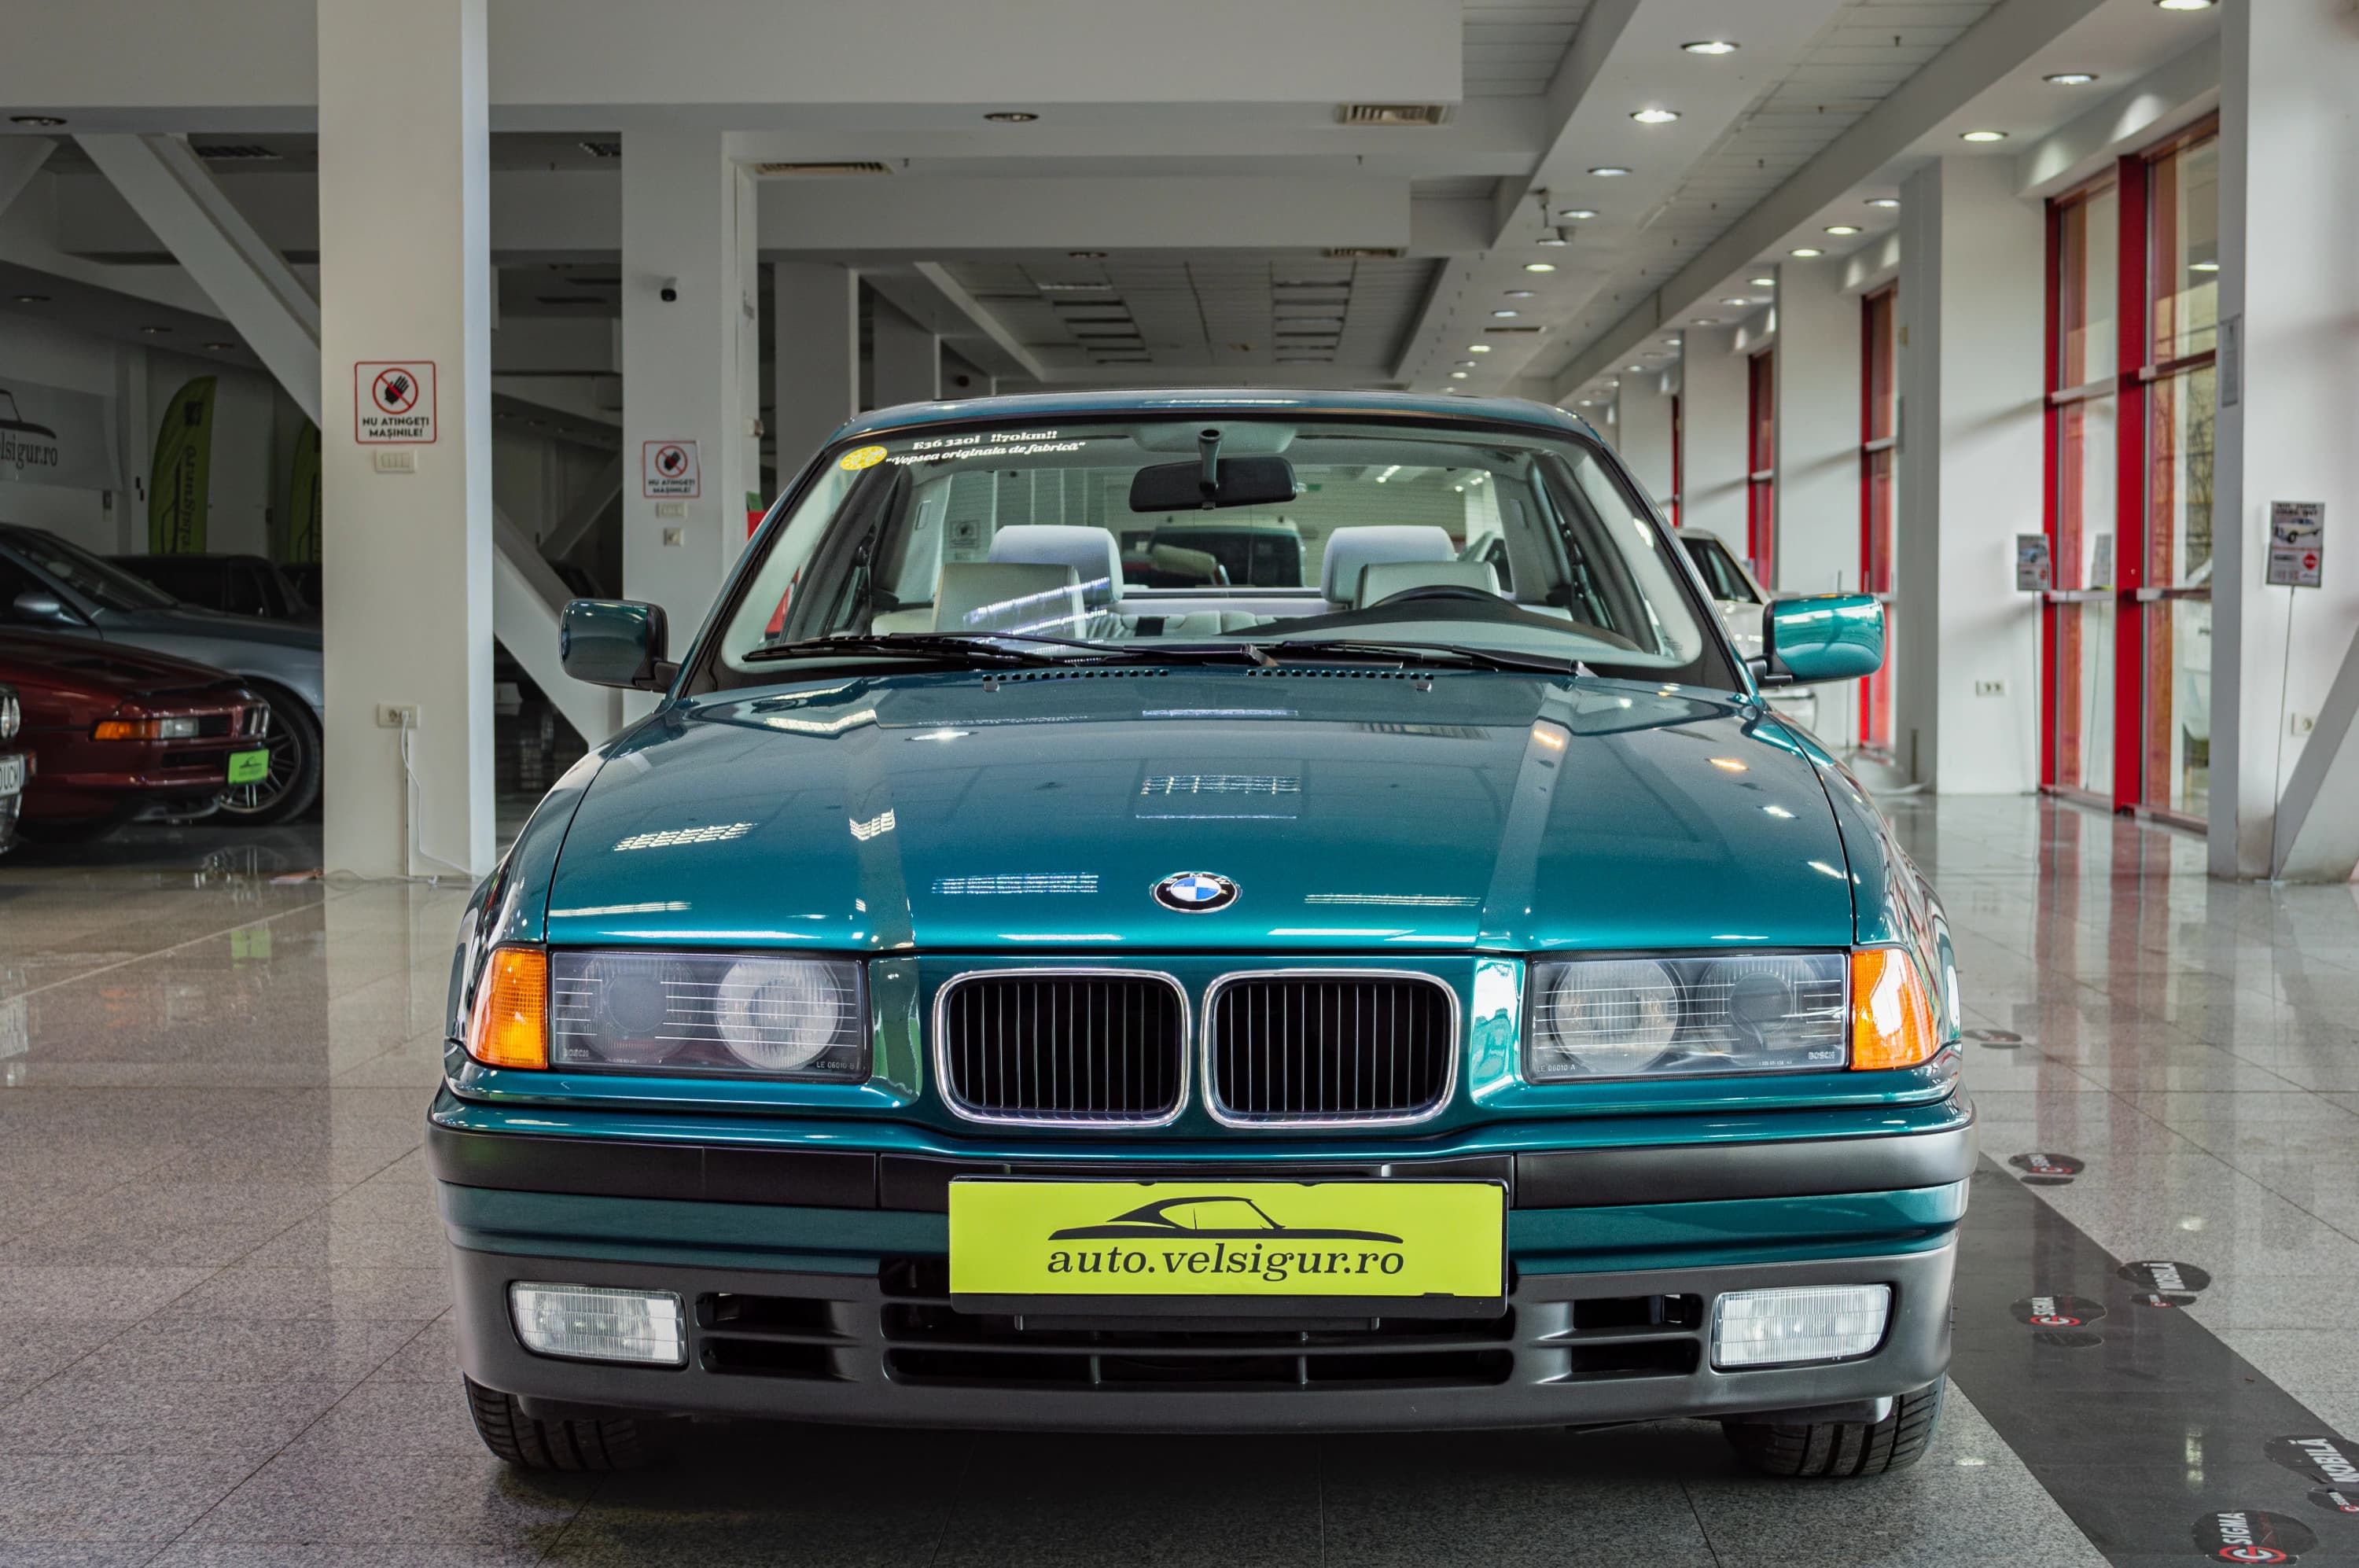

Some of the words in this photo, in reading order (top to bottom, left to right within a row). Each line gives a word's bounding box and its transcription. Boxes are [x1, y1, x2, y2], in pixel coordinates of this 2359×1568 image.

[362, 417, 377, 425] NU
[381, 417, 429, 428] ATINGEȚI
[369, 428, 422, 439] MAȘINILE!
[0, 432, 57, 469] lsigur.ro
[912, 440, 942, 450] E36
[1008, 445, 1026, 455] de
[1164, 873, 1231, 885] BMW
[1808, 1051, 1835, 1060] BOSCH
[1047, 1242, 1404, 1282] auto.velsigur.ro
[2217, 1513, 2254, 1545] SIGMA
